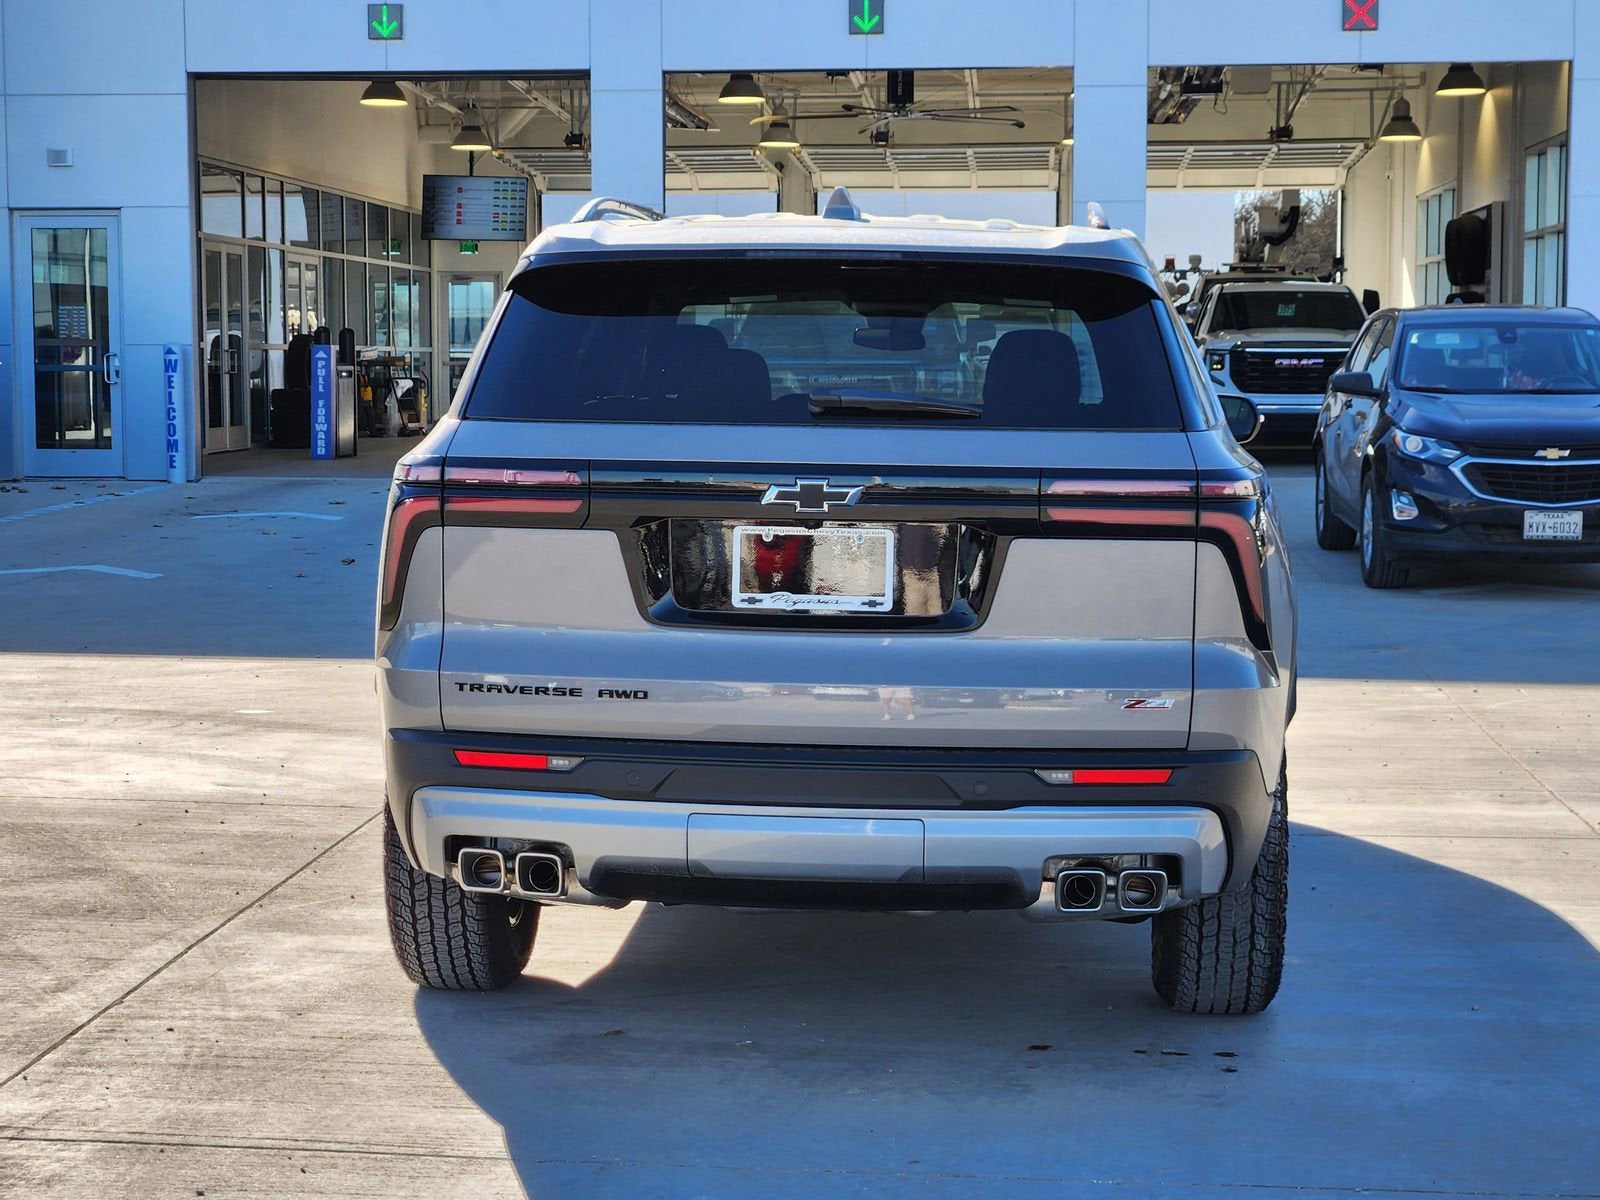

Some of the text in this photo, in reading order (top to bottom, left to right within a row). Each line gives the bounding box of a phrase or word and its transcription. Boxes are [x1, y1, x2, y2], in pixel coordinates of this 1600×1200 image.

[1274, 358, 1325, 368] GMC
[164, 358, 179, 469] WELCOME
[315, 360, 328, 455] PULL FORWARD
[741, 527, 886, 537] www.PegasusChevyTexas.com
[770, 593, 852, 608] Pegasus
[454, 681, 649, 700] TRAVERSE AWD
[1120, 697, 1175, 711] Z71
